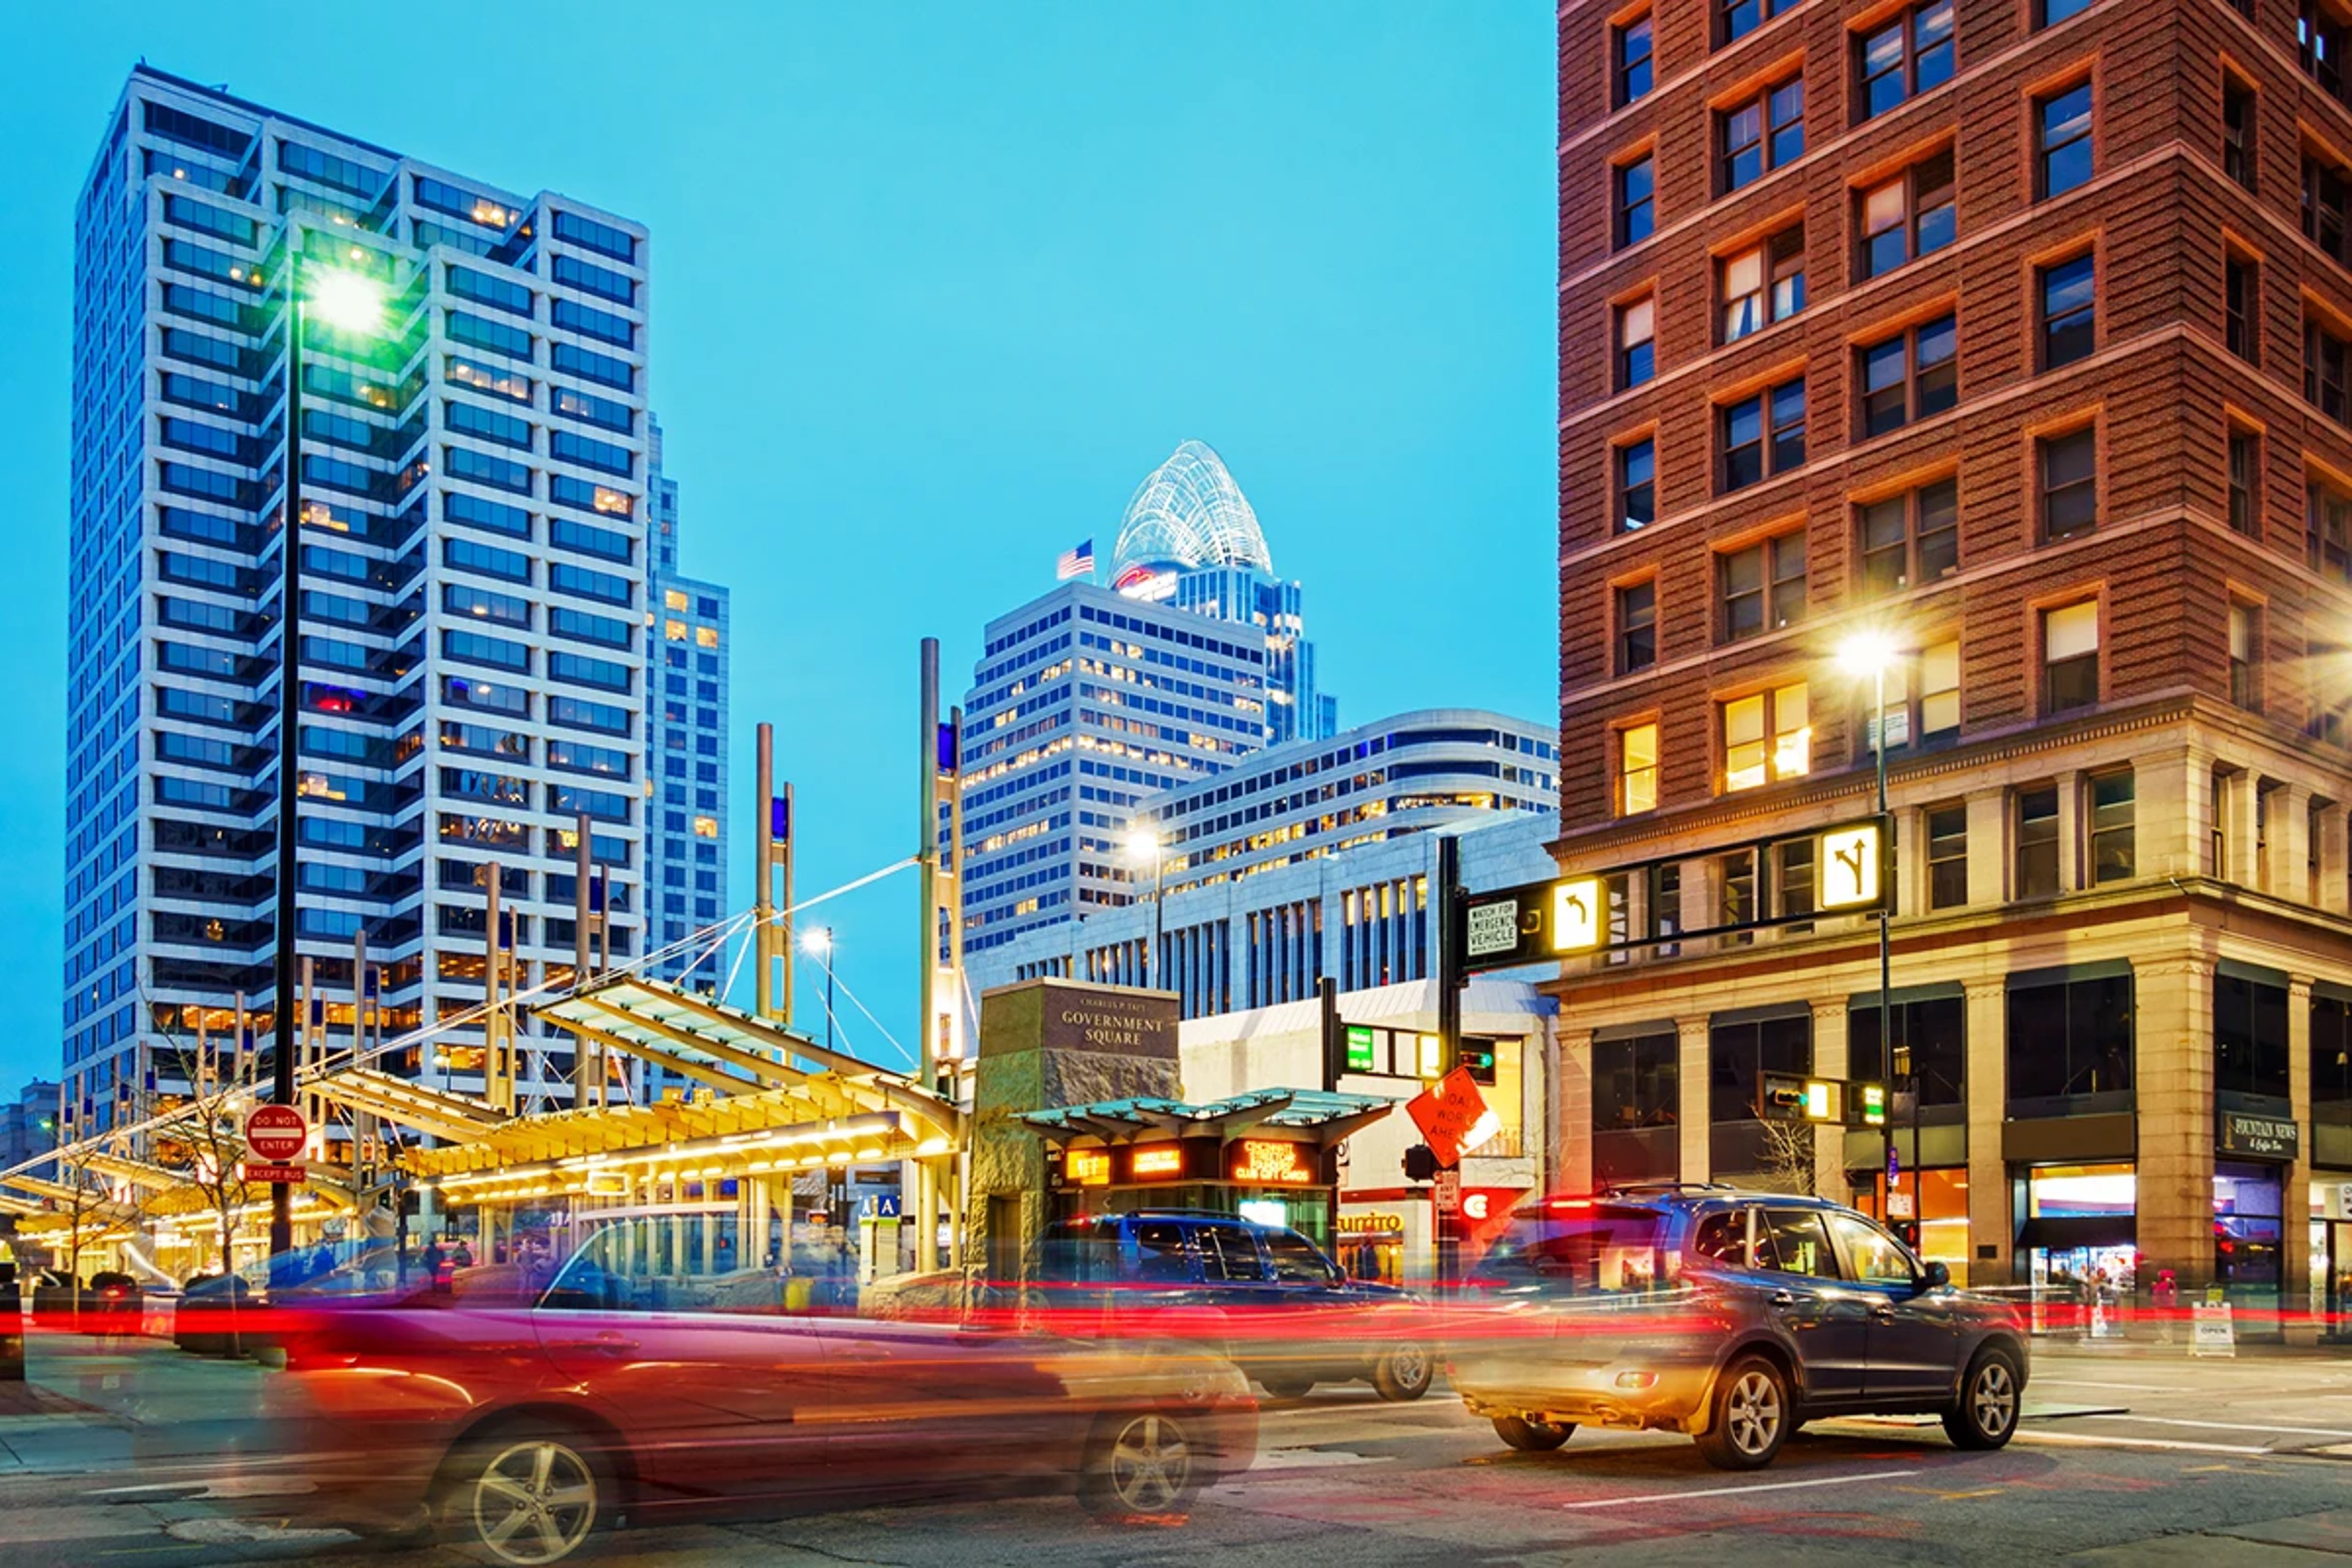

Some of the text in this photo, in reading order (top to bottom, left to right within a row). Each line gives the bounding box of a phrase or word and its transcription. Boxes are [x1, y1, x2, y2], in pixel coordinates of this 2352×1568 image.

[1472, 903, 1513, 919] WATCH FOR
[1470, 915, 1515, 933] EMERGENCY
[1471, 926, 1514, 945] VEHICLE
[1061, 1011, 1164, 1032] GOVERNMENT
[1085, 1028, 1142, 1046] SQUARE
[254, 1116, 297, 1126] DO NOT
[2236, 1118, 2296, 1140] FOUNTAIN NEWS
[260, 1140, 295, 1150] ENTER
[247, 1169, 303, 1180] EXCEPT BUS
[881, 1199, 894, 1215] A
[1337, 1211, 1401, 1233] urrito
[2201, 1326, 2227, 1335] OPEN
